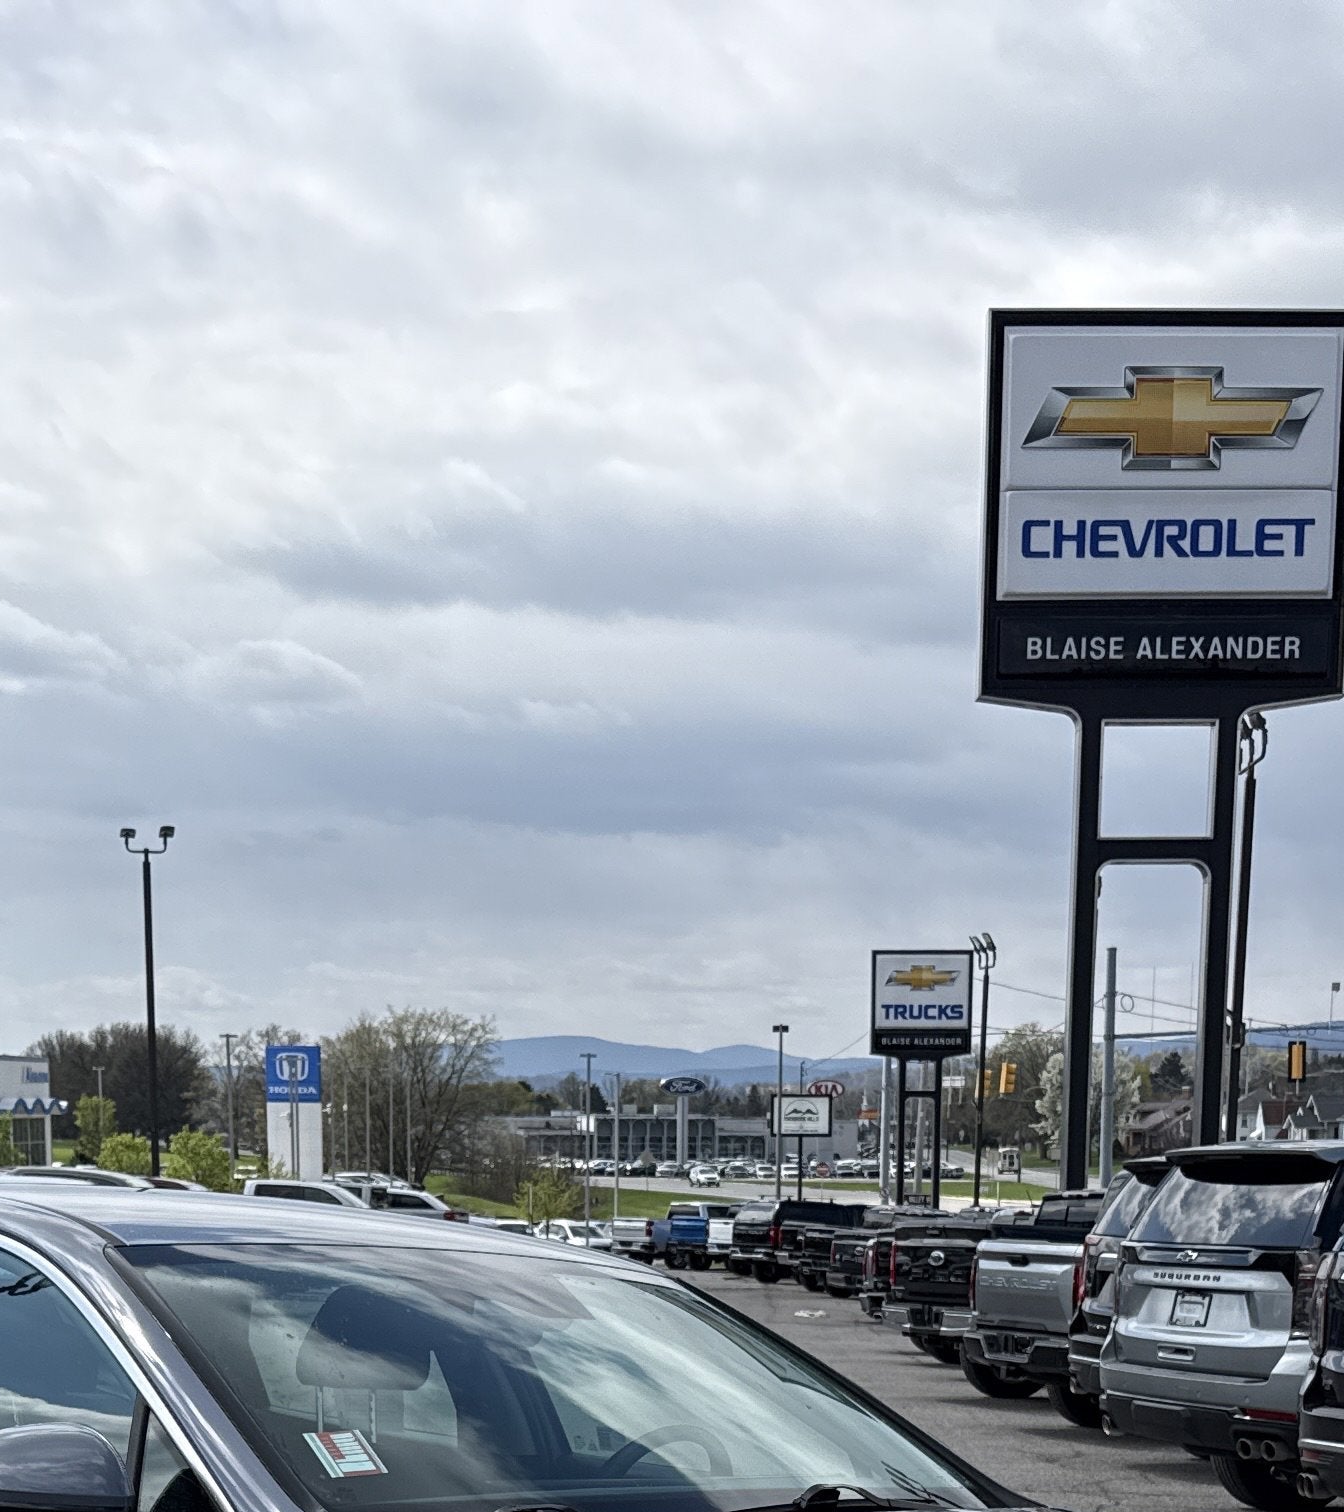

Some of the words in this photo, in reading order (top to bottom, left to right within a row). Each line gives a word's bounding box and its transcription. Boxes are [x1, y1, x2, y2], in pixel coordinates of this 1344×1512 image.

[1021, 518, 1316, 558] CHEVROLET
[1025, 636, 1125, 661] BLAISE
[1135, 636, 1301, 660] ALEXANDER
[880, 1004, 964, 1020] TRUCKS
[881, 1037, 910, 1046] BLAISE
[913, 1037, 963, 1046] ALEXANDER
[268, 1086, 317, 1094] HODA
[815, 1084, 840, 1097] KIA
[1152, 1271, 1221, 1283] SUBURBAN
